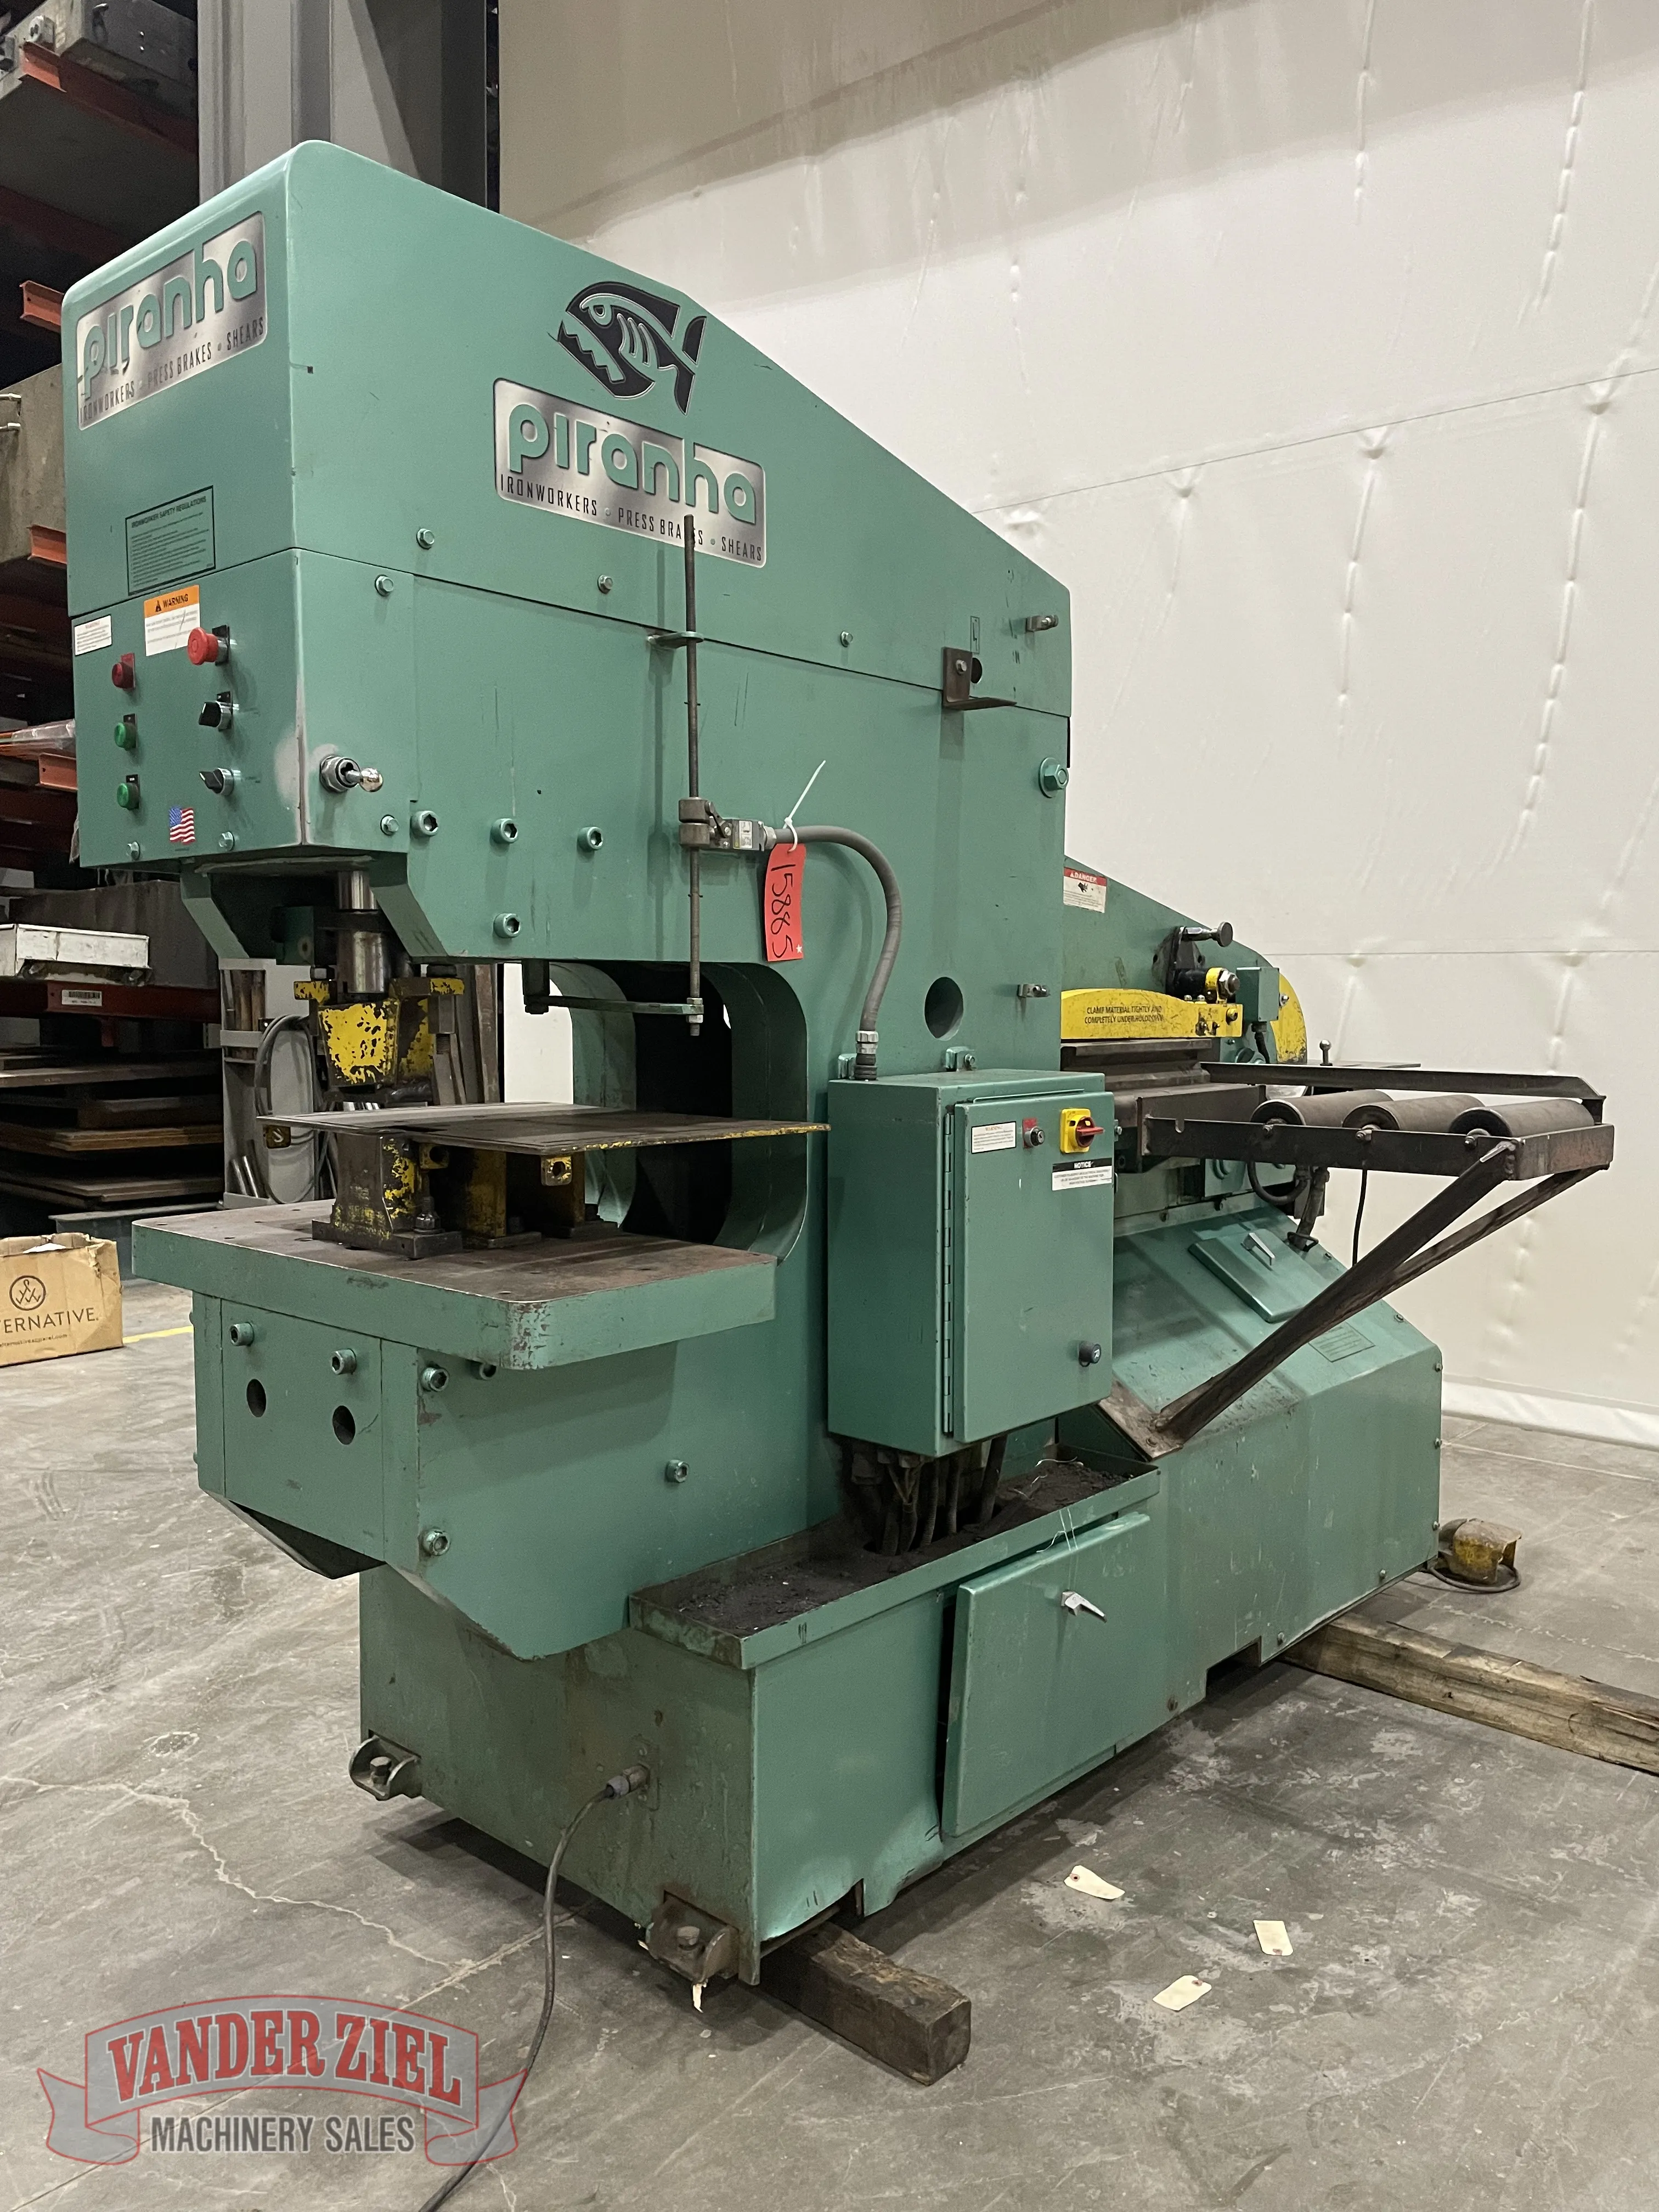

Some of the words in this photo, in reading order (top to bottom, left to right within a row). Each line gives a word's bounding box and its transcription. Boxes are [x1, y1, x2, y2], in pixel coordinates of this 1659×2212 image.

[83, 240, 257, 400] piranha
[80, 381, 135, 424] IRONWORKERS
[148, 363, 173, 387] PRESS
[177, 342, 212, 375] BRAKES
[227, 317, 264, 351] SHEARS
[509, 404, 756, 526] piranha
[500, 474, 597, 516] IRONWORKERS
[618, 507, 654, 532] PRESS
[660, 519, 703, 545] BRAS
[721, 537, 762, 562] SHEARS
[162, 594, 189, 608] WARNING
[771, 864, 796, 958] 15885
[1074, 872, 1097, 883] DANGER
[1074, 1161, 1092, 1169] NOTICE
[0, 1307, 99, 1333] ERNATIVE.
